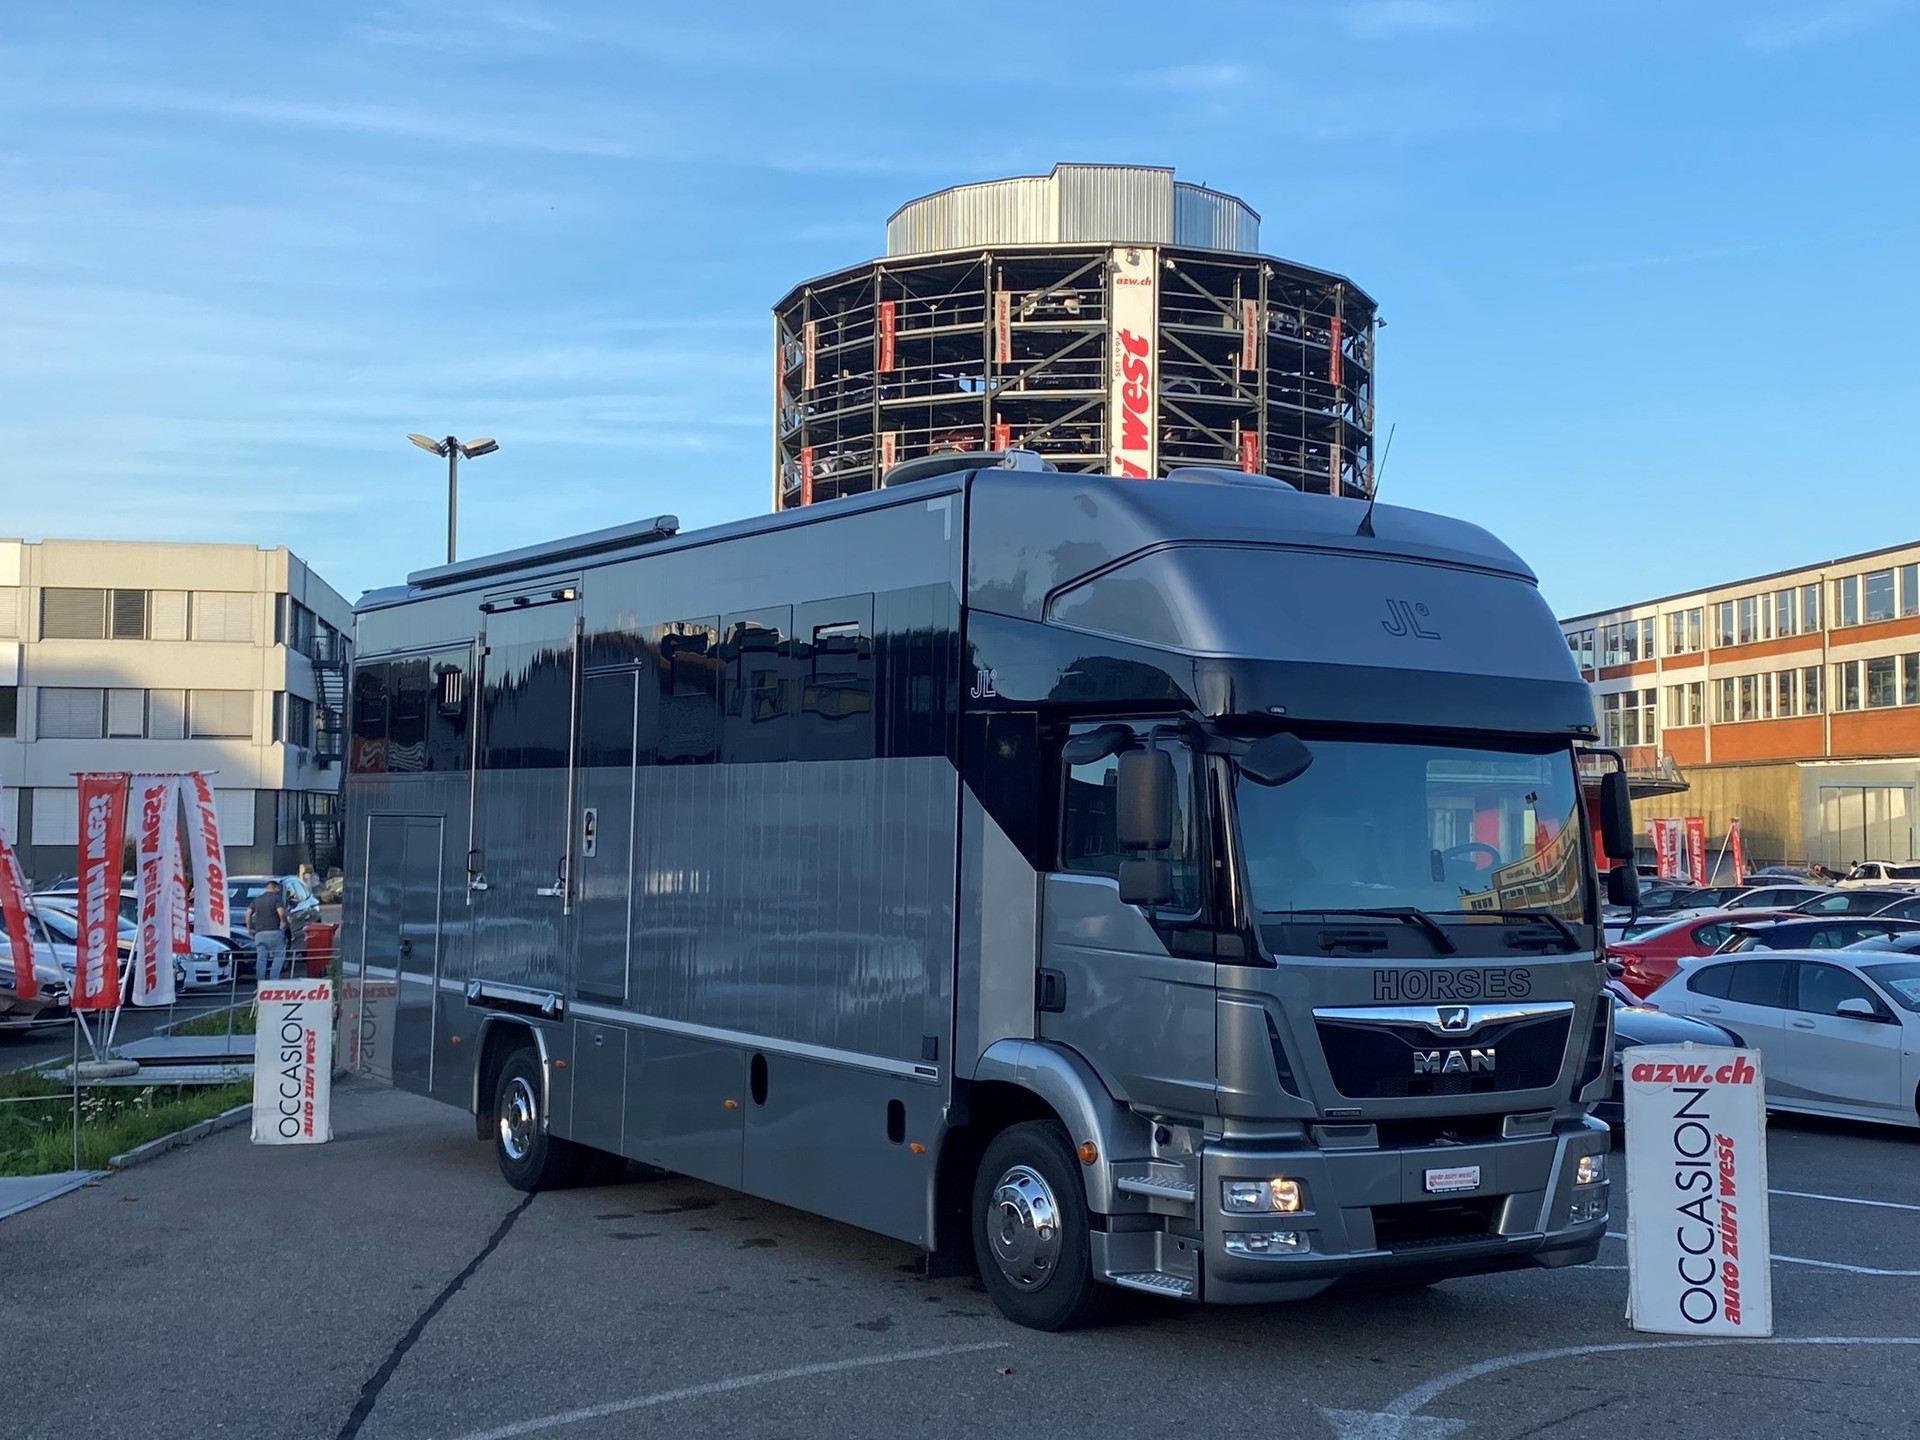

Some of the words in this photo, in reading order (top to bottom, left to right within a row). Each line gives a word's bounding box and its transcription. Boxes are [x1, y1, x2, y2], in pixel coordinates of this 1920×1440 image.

[1116, 276, 1152, 286] azw.ch
[1117, 328, 1149, 450] west
[193, 771, 212, 804] we
[197, 804, 221, 862] züri
[1691, 829, 1700, 857] west
[207, 862, 224, 926] auto
[173, 882, 187, 944] auto
[259, 984, 329, 1002] azw.ch
[1373, 968, 1532, 1000] HORSES
[304, 1028, 316, 1065] west
[1413, 1049, 1496, 1074] MAN
[278, 1002, 304, 1138] OCCASION
[304, 1066, 315, 1100] züri
[1631, 1056, 1755, 1084] azw.ch
[304, 1101, 314, 1137] auto
[1714, 1132, 1736, 1197] west
[1672, 1088, 1718, 1324] OCCASION
[1716, 1198, 1739, 1261] züri
[1720, 1259, 1741, 1326] auto
